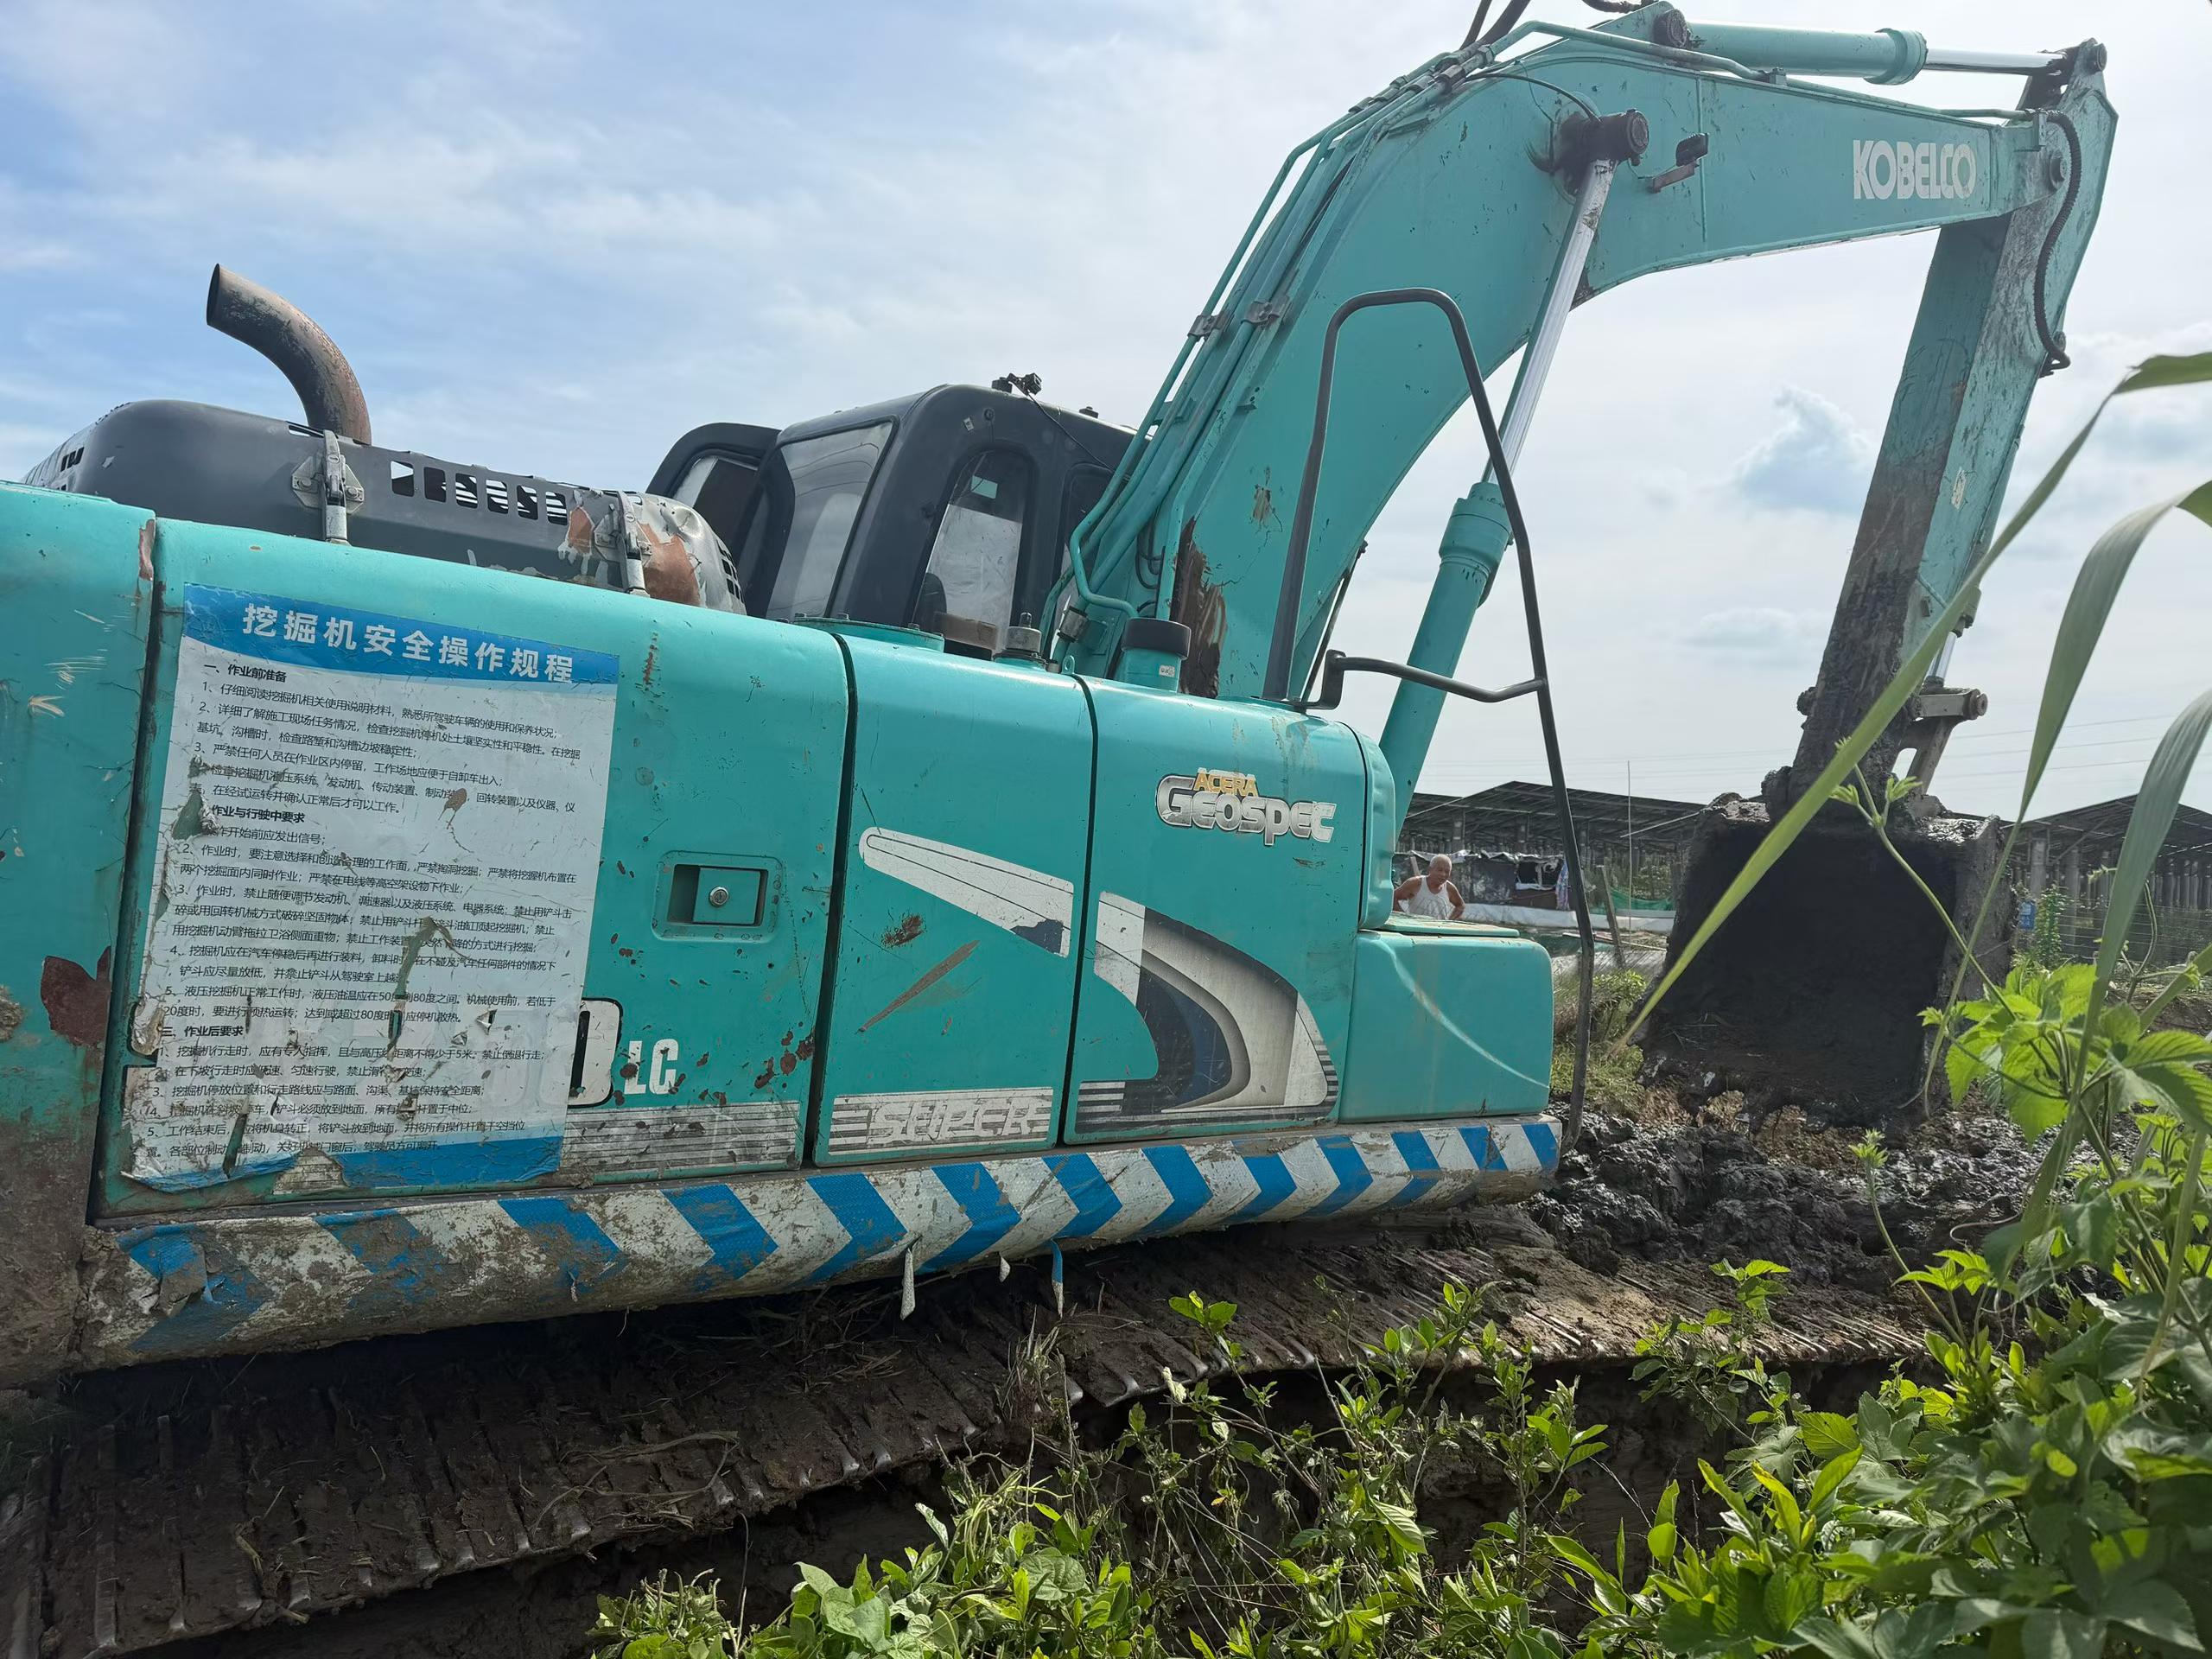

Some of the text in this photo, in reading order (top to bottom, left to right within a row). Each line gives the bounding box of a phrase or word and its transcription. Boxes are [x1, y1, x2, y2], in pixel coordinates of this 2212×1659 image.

[1853, 139, 1977, 200] KOBELCO
[242, 605, 575, 683] 挖掘机安全操作规程
[203, 661, 288, 683] 一、作业前准备
[1192, 767, 1260, 798] ACERA
[191, 804, 305, 823] 作业与行驶中要求
[175, 904, 556, 936] 碎或用回转机械方式破碎坚固物体；禁止用铲斗杆铲斗油缸顶起挖掘机；禁止
[162, 1025, 244, 1039] 三、作业后要求
[623, 1039, 679, 1096] LC
